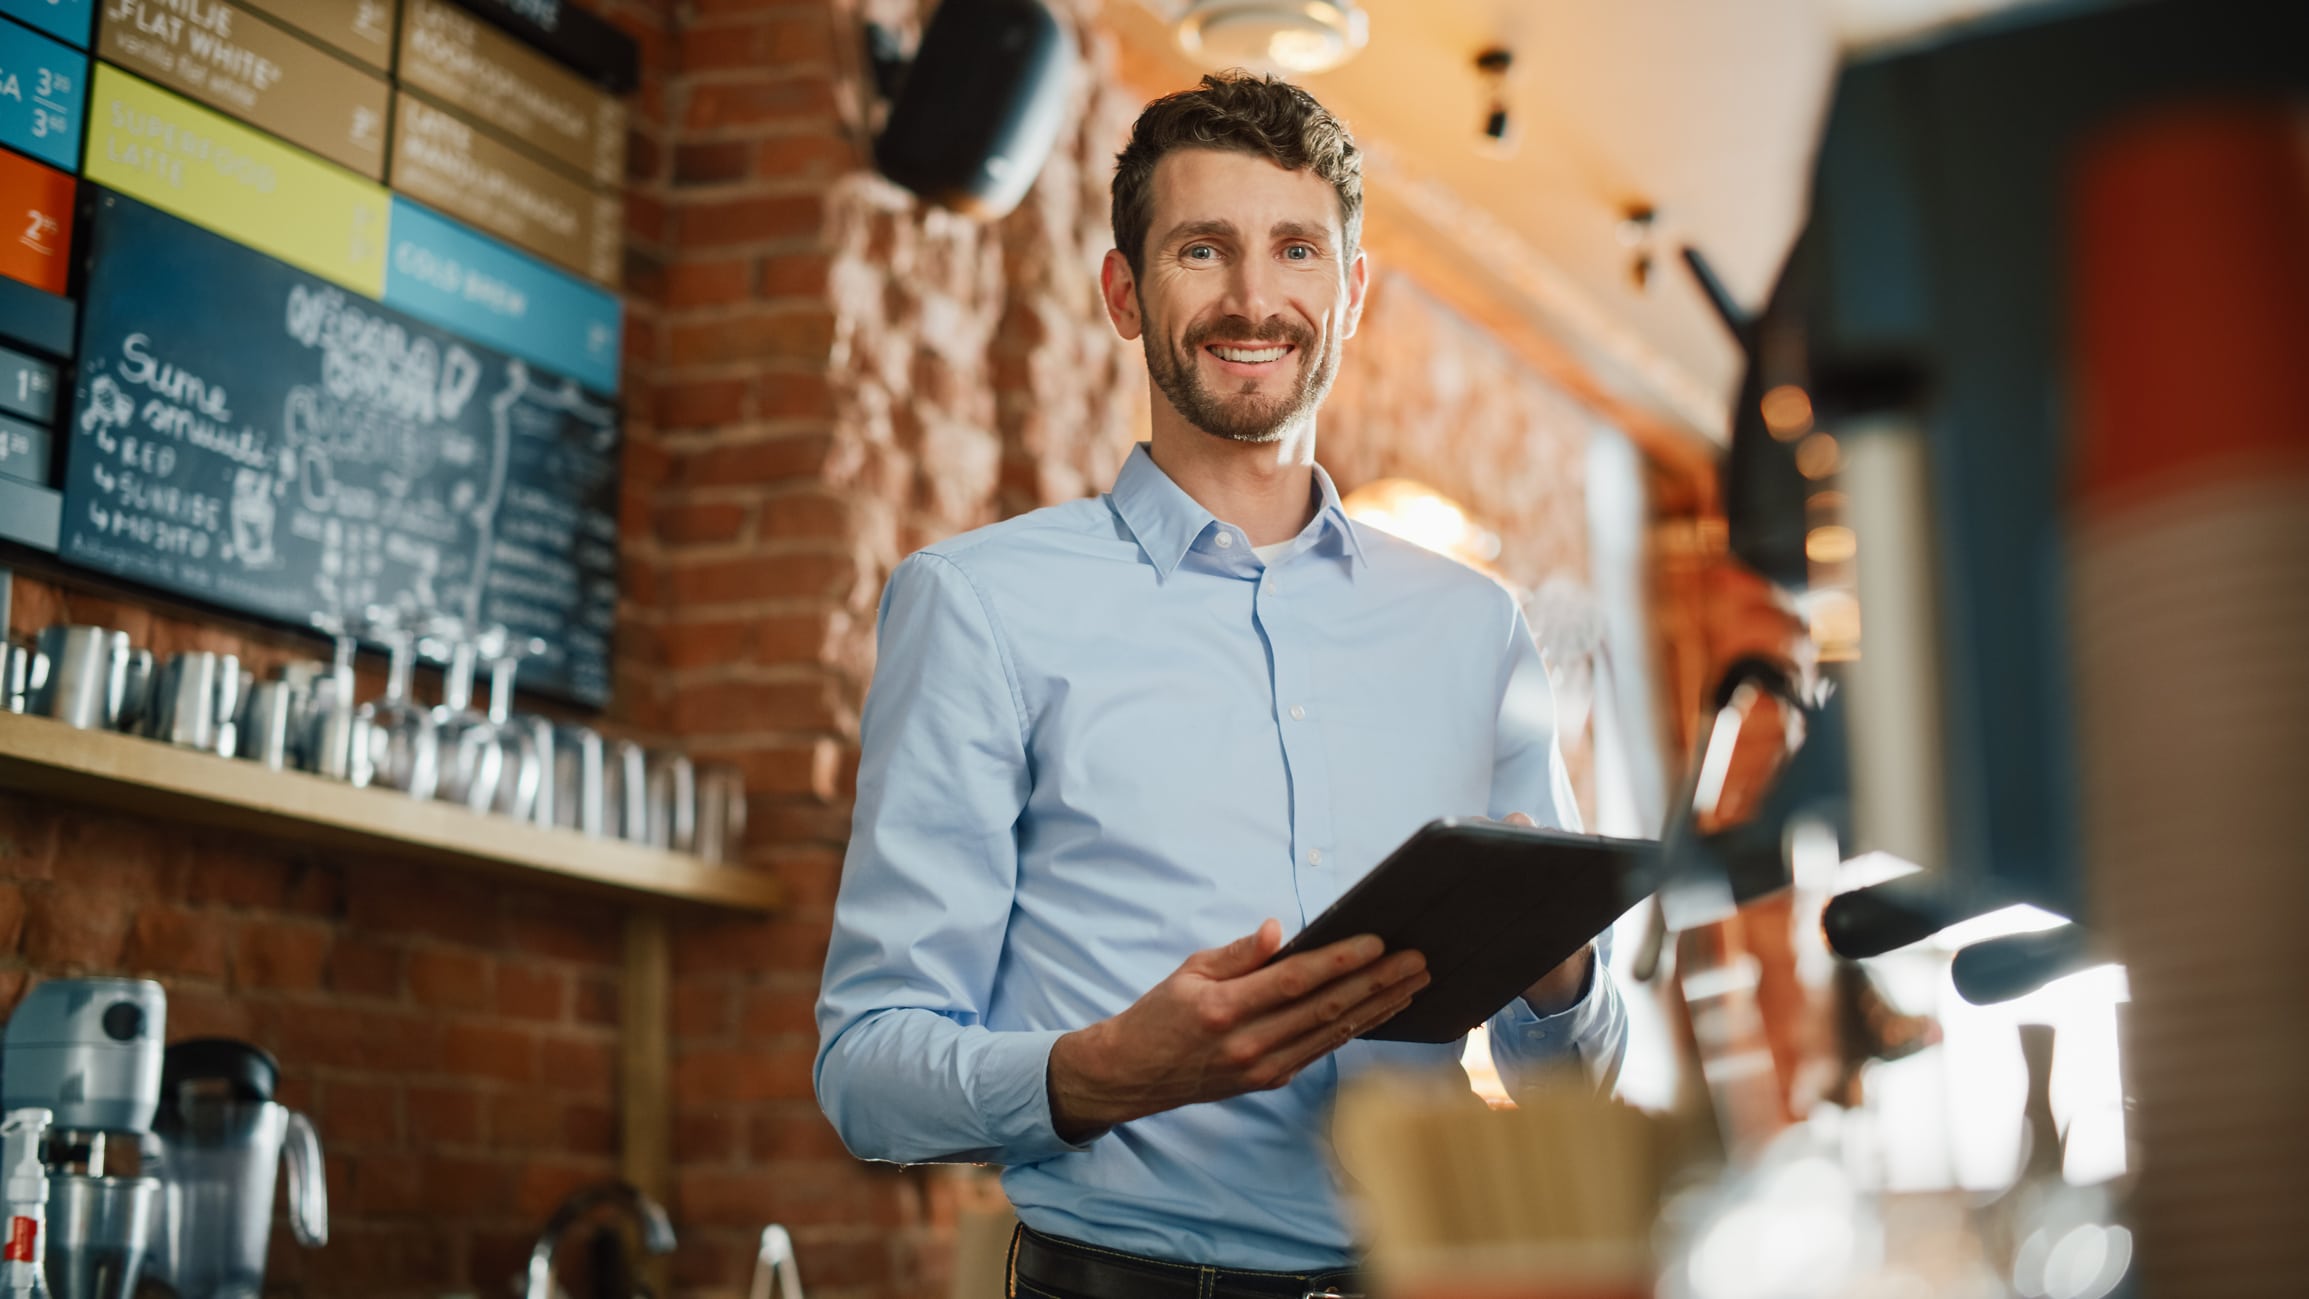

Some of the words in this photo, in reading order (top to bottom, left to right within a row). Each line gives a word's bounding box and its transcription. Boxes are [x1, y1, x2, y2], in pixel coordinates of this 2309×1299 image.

[106, 134, 186, 190] LATTE
[110, 99, 278, 194] SUPERFOOD
[117, 332, 233, 424] Sume
[121, 436, 176, 479] RED
